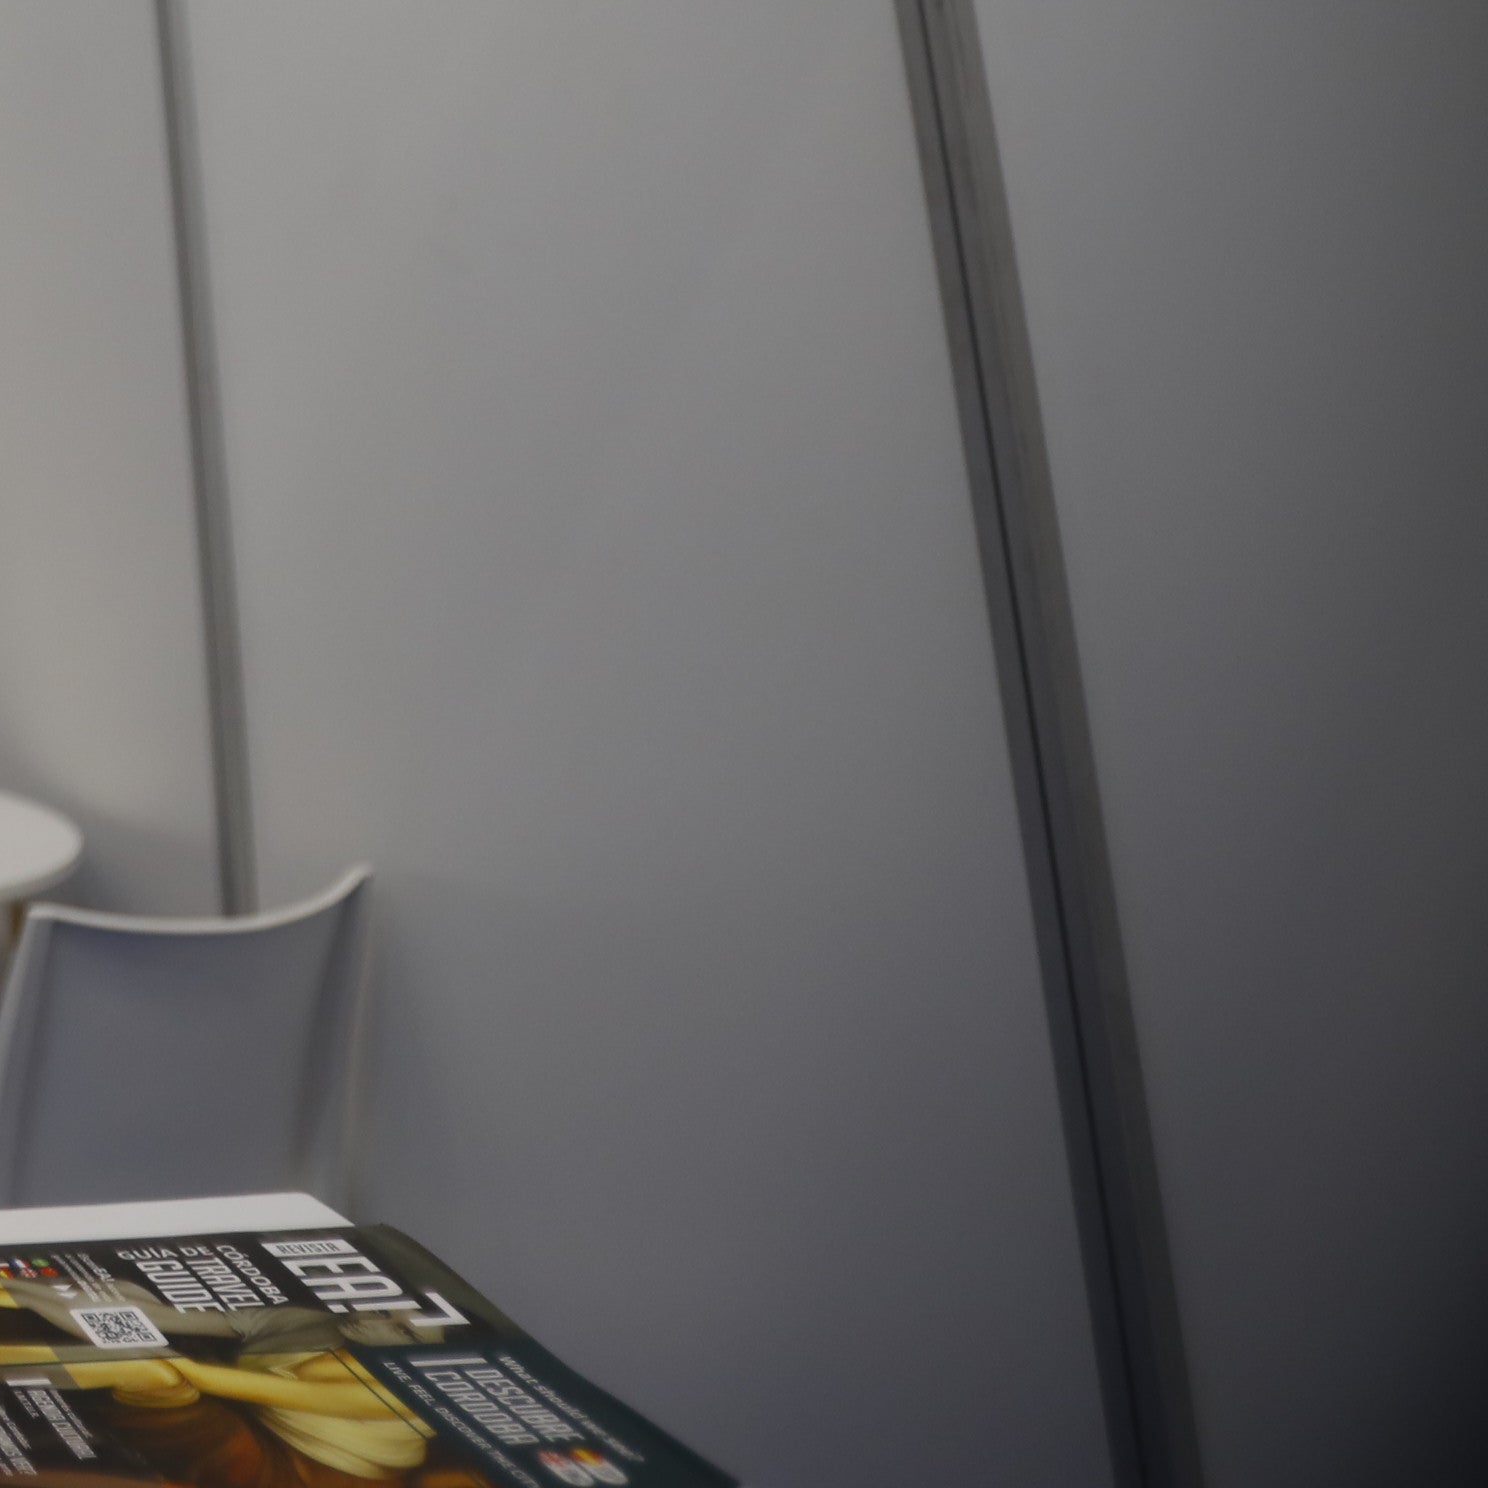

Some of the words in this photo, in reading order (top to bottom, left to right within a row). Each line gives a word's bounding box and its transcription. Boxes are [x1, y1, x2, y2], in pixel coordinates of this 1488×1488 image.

[117, 1247, 178, 1261] GUÍA
[176, 1246, 216, 1256] DE
[276, 1241, 340, 1254] REVISTA
[135, 1260, 224, 1313] GUIDE
[184, 1257, 266, 1311] TRAVEL
[215, 1244, 289, 1305] CÓRDOBA
[463, 1368, 587, 1442] DESCUBRE
